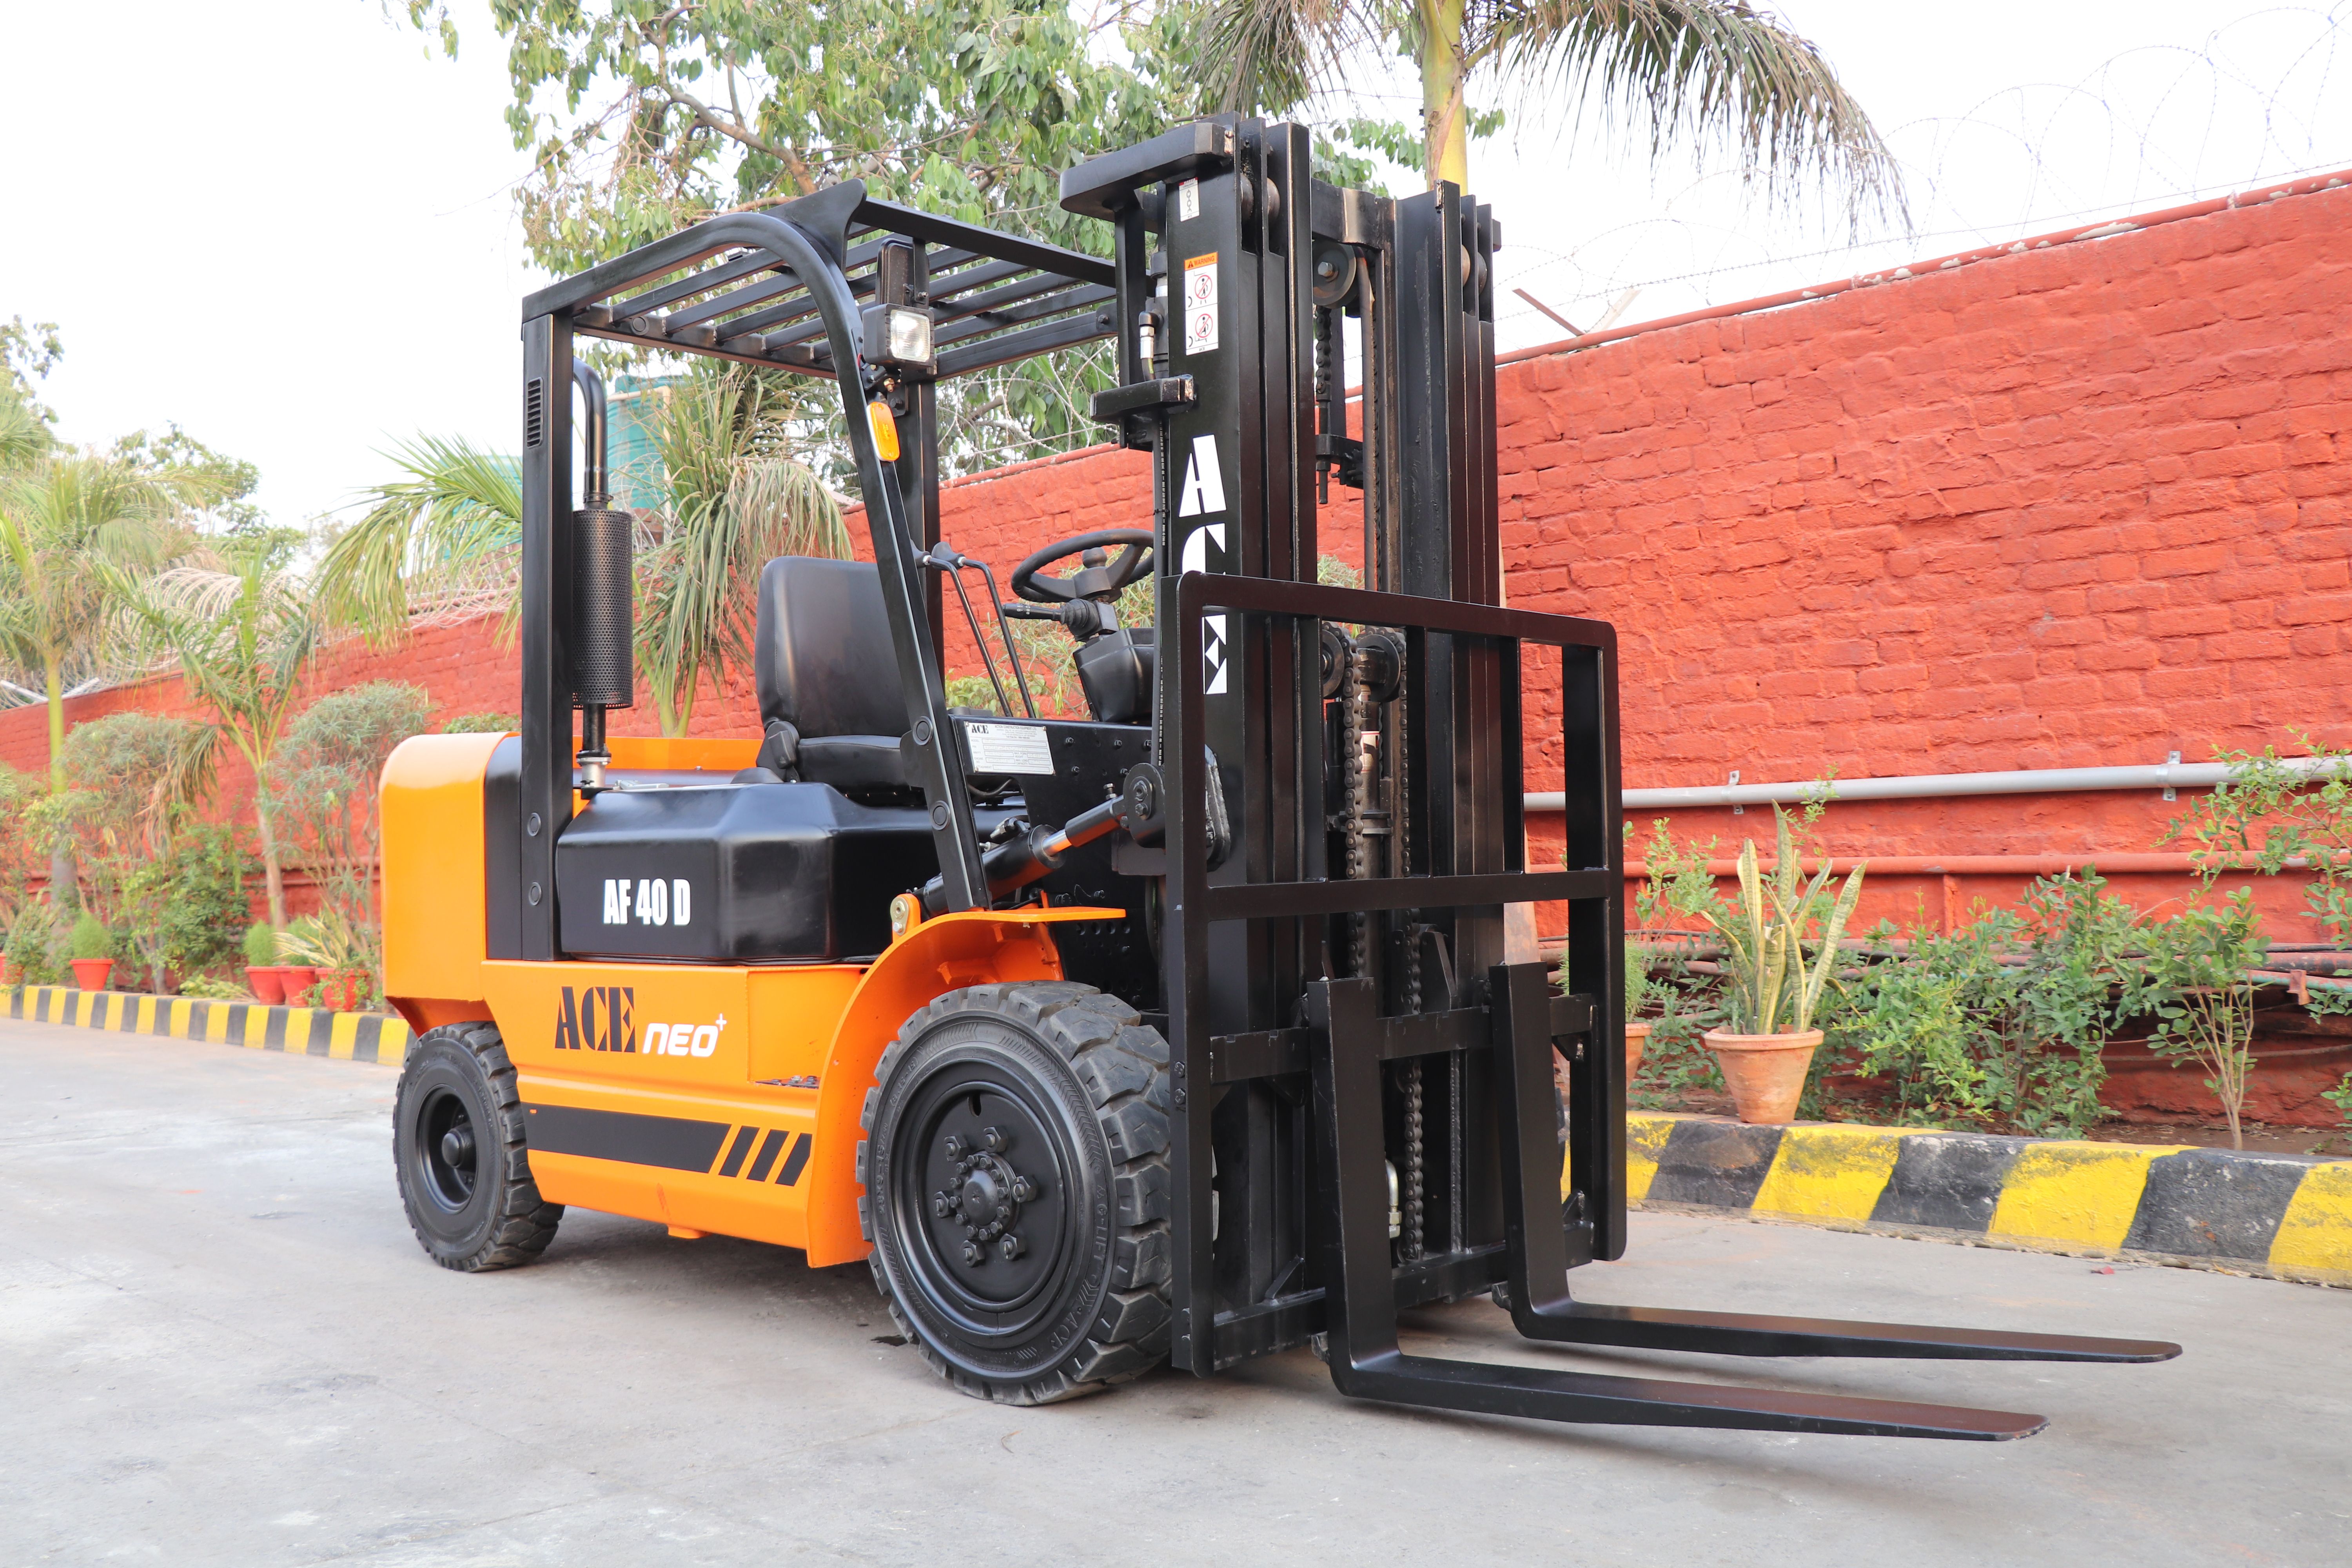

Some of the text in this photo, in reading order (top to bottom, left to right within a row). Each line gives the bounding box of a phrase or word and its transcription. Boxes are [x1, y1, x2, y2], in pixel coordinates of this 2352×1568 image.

[1194, 256, 1214, 266] WARNING
[972, 724, 989, 734] ACE
[603, 878, 691, 926] AF 40 D
[555, 986, 636, 1053] ACE
